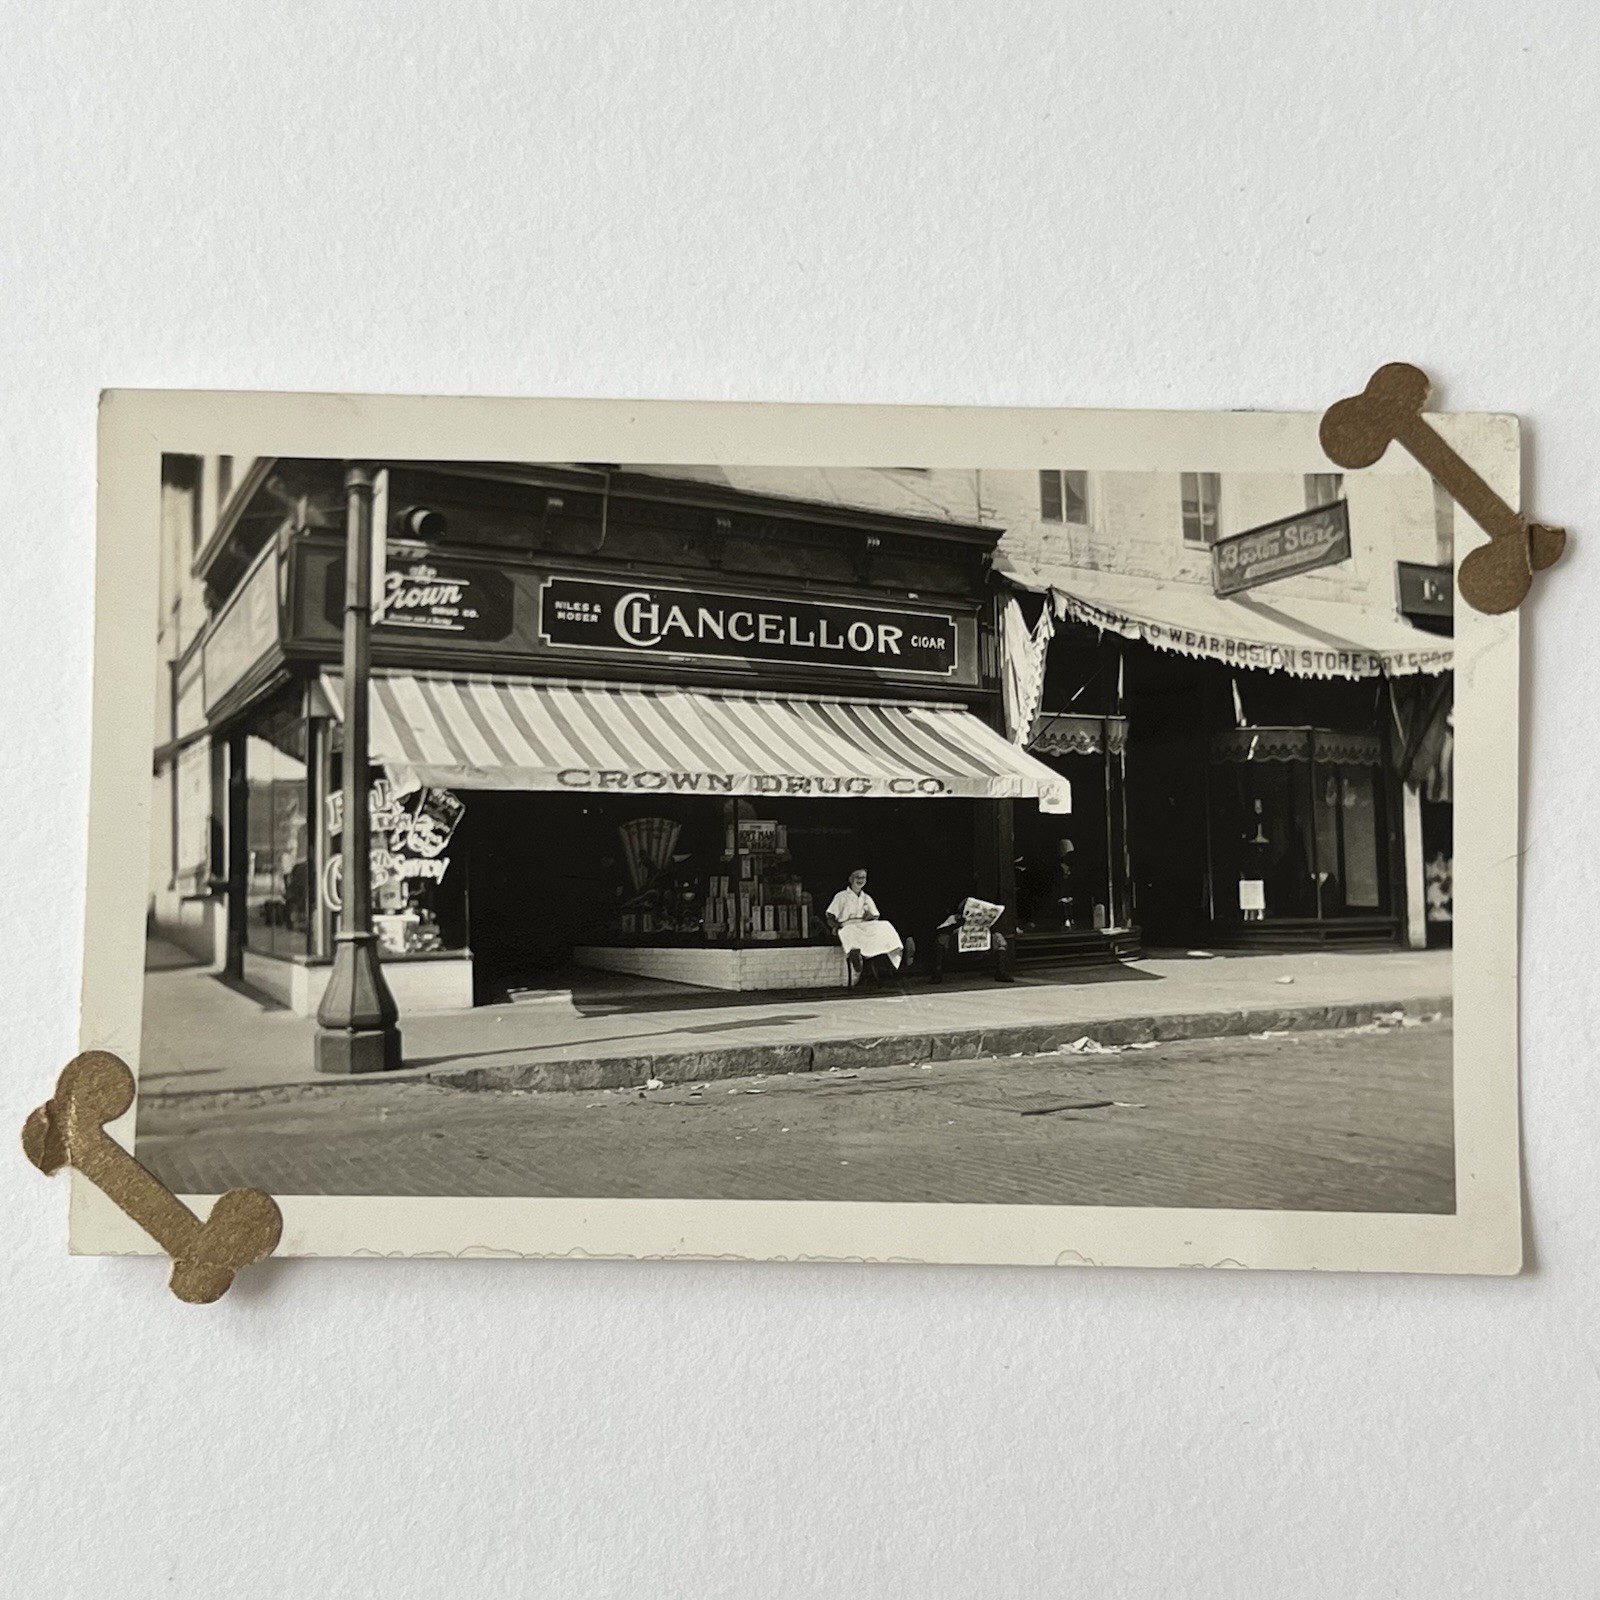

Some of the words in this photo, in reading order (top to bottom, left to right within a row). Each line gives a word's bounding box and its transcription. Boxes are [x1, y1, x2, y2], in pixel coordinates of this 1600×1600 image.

[1220, 530, 1281, 570] Boston
[1284, 524, 1337, 551] Store
[384, 571, 463, 609] Crown
[555, 600, 590, 613] NILES
[557, 611, 599, 623] MOSER
[614, 592, 903, 655] CHANCELLOR
[910, 634, 946, 650] CIGAR
[1169, 627, 1219, 651] WEAR
[1225, 637, 1295, 668] BOSTON
[1301, 649, 1362, 672] STORE
[1368, 652, 1404, 670] DRY
[556, 768, 735, 792] CROWN
[754, 774, 873, 794] DRUG
[888, 777, 953, 795] CO.
